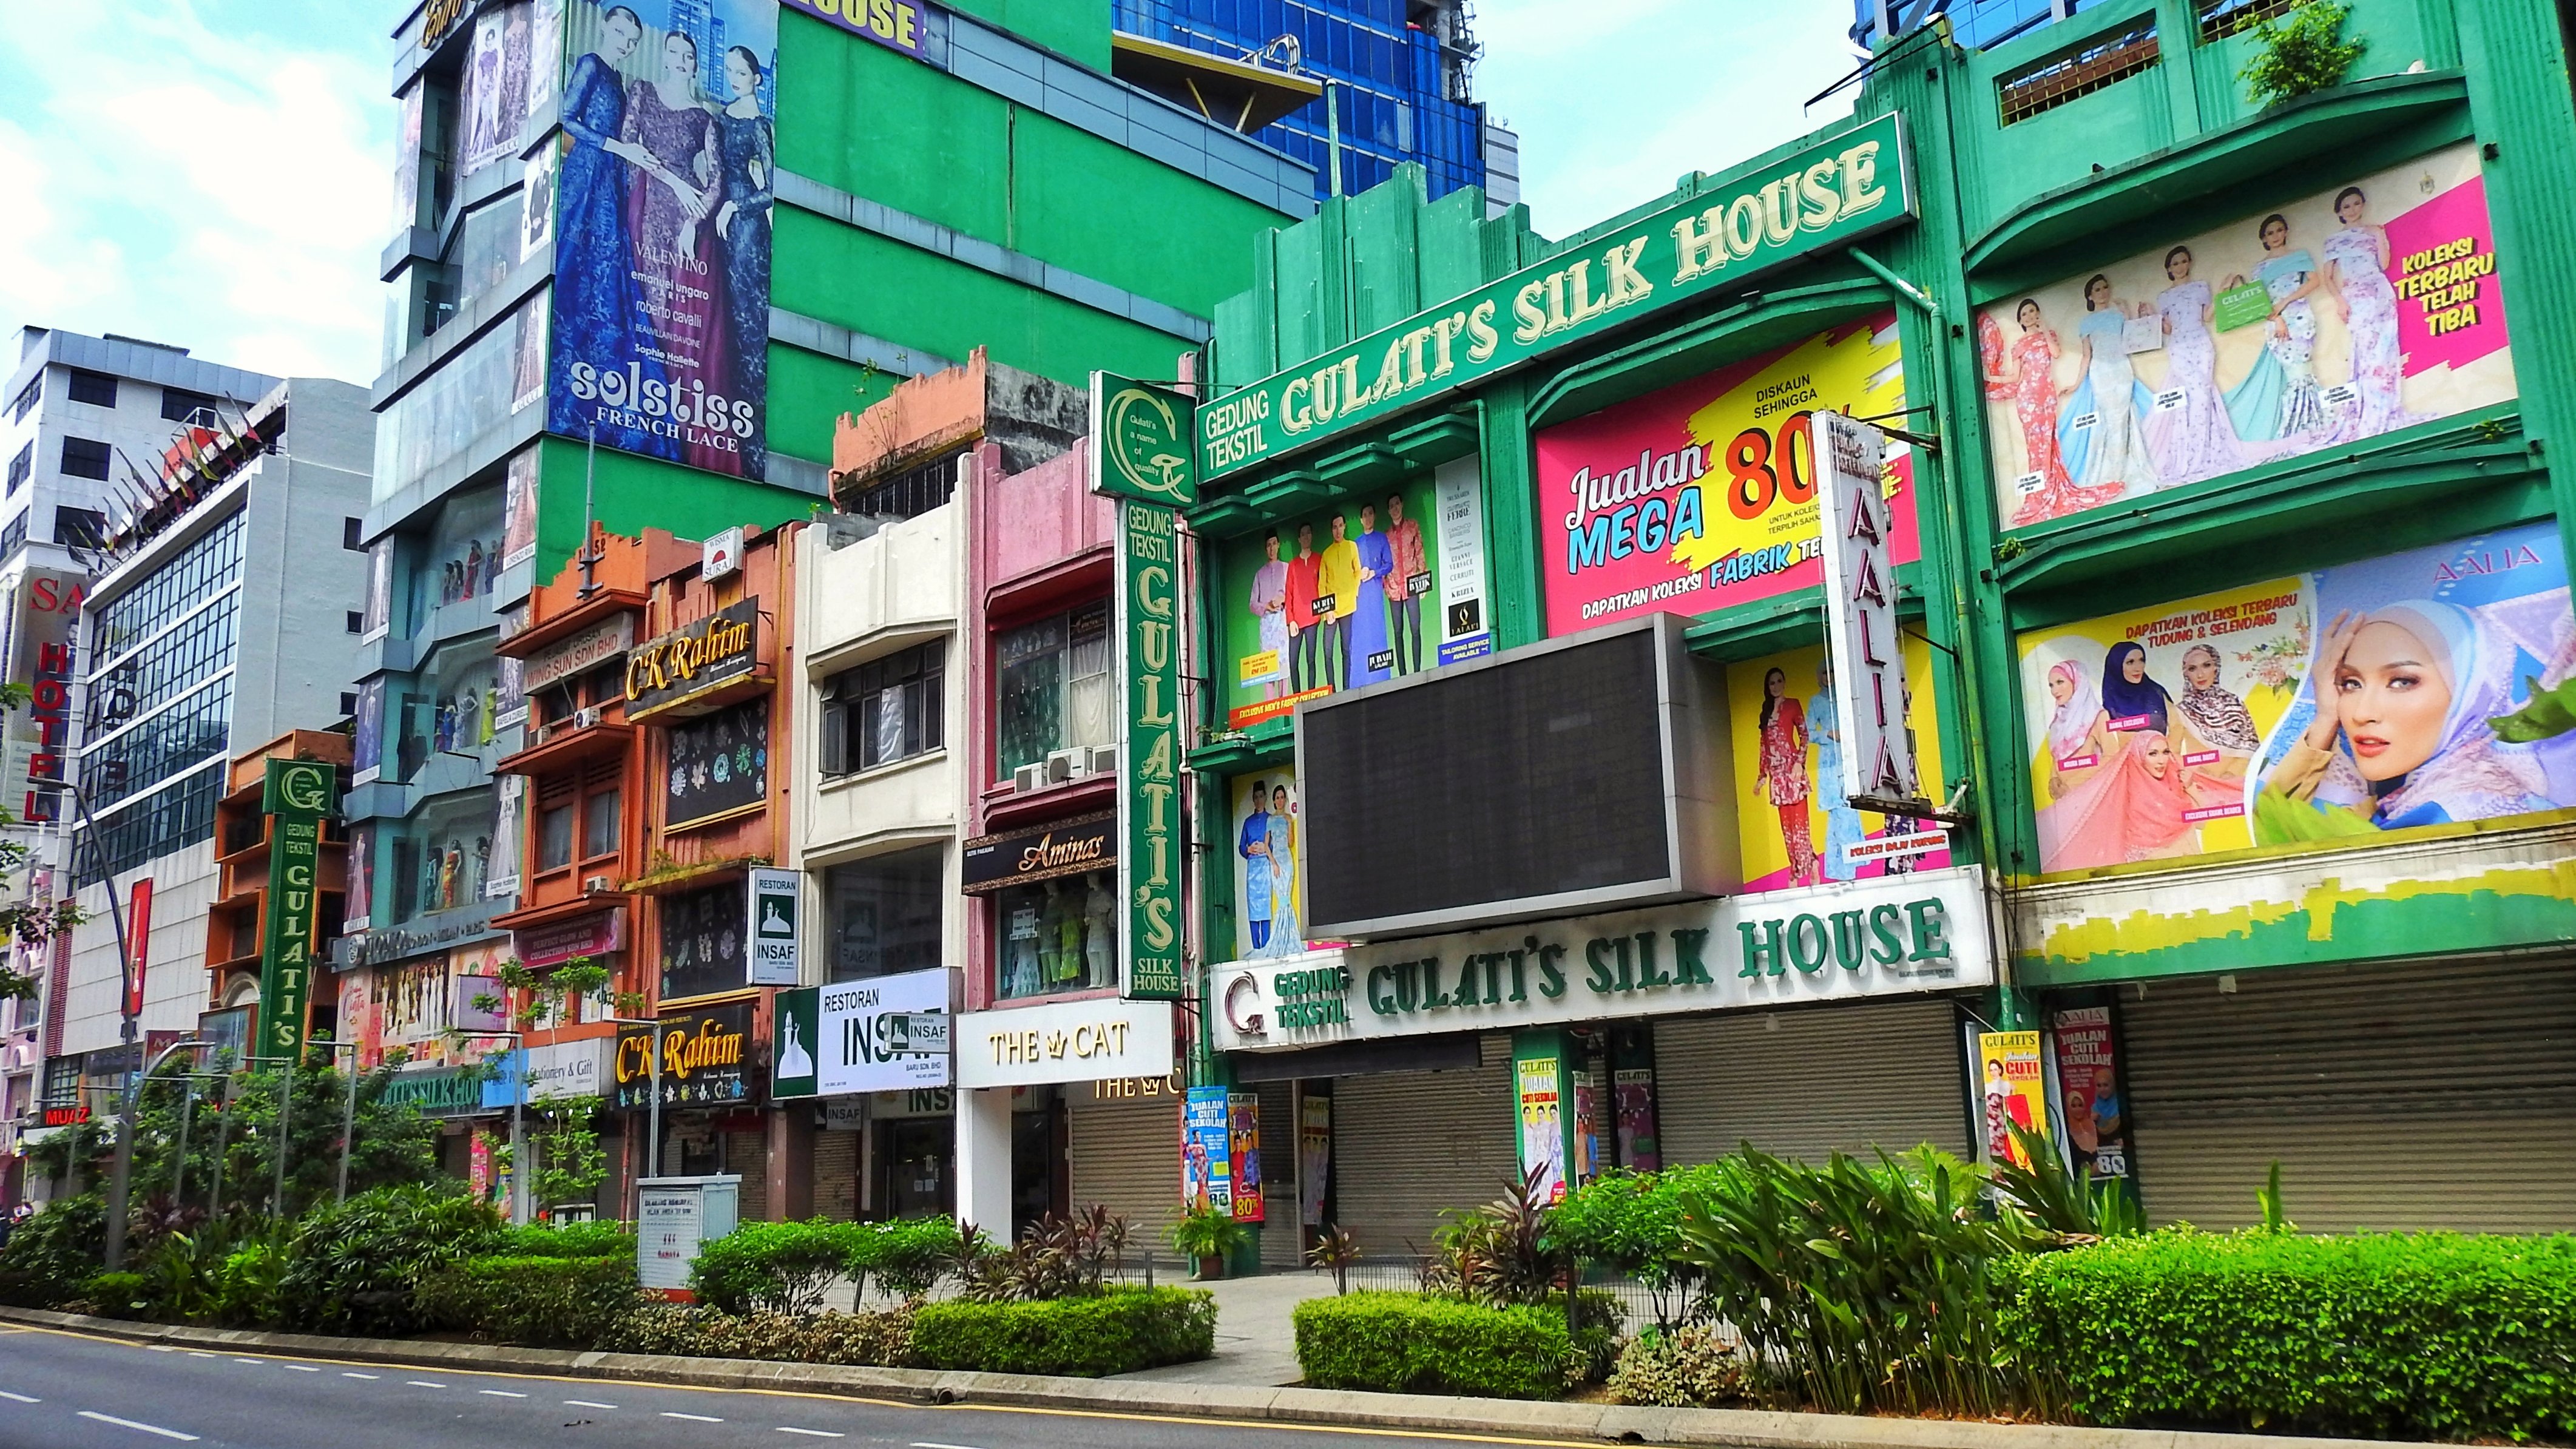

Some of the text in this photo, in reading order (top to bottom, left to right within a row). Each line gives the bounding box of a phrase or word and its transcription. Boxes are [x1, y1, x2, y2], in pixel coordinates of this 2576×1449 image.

[798, 0, 916, 50] USE
[636, 242, 708, 275] VALENTINO
[2402, 237, 2473, 274] KOLEKSI
[631, 271, 709, 300] emanuel ungaro
[1279, 140, 1887, 436] GULATI'S SILK HOUSE
[2393, 252, 2495, 300] TERBARU
[652, 287, 686, 303] PARIS
[2419, 280, 2476, 312] TELAH
[636, 300, 701, 328] roberto cavalli
[2424, 304, 2476, 336] TIBA
[635, 343, 665, 359] Sophie
[571, 361, 754, 438] solstiss
[1757, 374, 1811, 402] DISKAUN
[1206, 390, 1269, 439] GEDUNG
[1754, 388, 1818, 419] SEHINGGA
[597, 406, 739, 453] FRENCH LACE
[1130, 414, 1156, 430] Gulati's
[1134, 447, 1141, 456] of
[1137, 434, 1157, 445] name
[1206, 424, 1268, 470] TEKSTIL
[1135, 463, 1159, 476] quality
[1565, 444, 1705, 530] Jualan
[1128, 505, 1172, 536] GEDUNG
[1567, 485, 1703, 575] MEGA
[1768, 521, 1798, 535] TERPILIH
[1769, 512, 1793, 524] UNTUK
[709, 534, 730, 547] WISMA
[1129, 532, 1171, 562] TEKSTIL
[704, 558, 732, 578] SURAJ
[1449, 559, 1473, 570] VERSACE
[1450, 569, 1474, 582] CERRUTI
[2433, 544, 2542, 586] AALIA
[1582, 535, 1824, 620] DAPATKAN KOLEKSI FABRIK TE
[1451, 587, 1474, 598] KRIZIA
[2126, 593, 2297, 639] DAPATKAN KOLEKSI TERBARU
[1848, 487, 1904, 794] AALIA
[2148, 612, 2277, 648] TUDUNG & SELENDANG
[527, 634, 618, 687] WING SUN SDN BHD
[671, 617, 750, 680] Rahim
[1240, 705, 1264, 718] EXCLUSIVE
[1265, 700, 1280, 713] MEN'S
[24, 643, 68, 821] HOTEL
[1134, 566, 1174, 952] GULATI'S
[286, 823, 315, 837] GEDUNG
[285, 841, 313, 855] TEKSTIL
[1019, 833, 1105, 871] Aminas
[759, 879, 796, 890] RESTORAN
[272, 865, 311, 1046] GULATI'S
[530, 945, 566, 961] COLLECTION
[757, 944, 794, 960] INSAF
[1367, 896, 1950, 1015] GULATI'S SILK HOUSE
[1138, 958, 1173, 974] SILK
[1133, 974, 1178, 991] HOUSE
[1274, 965, 1354, 997] GEDUNG
[824, 988, 879, 1013] RESTORAN
[1275, 998, 1351, 1028] TEKSTIL
[843, 1008, 941, 1066] INS
[910, 1025, 947, 1038] INSAF
[989, 1021, 1129, 1064] THE CAT
[1985, 1034, 2036, 1048] GULATI'S
[2060, 1030, 2107, 1045] JUALAN
[664, 1019, 744, 1079] Rahim
[2061, 1053, 2112, 1066] SEKOLAH
[2070, 1042, 2099, 1054] CUTI
[567, 1062, 575, 1075] &
[576, 1059, 592, 1075] Gift
[1520, 1061, 1556, 1073] GULATI'S
[2006, 1062, 2040, 1075] CUTI
[1524, 1076, 1554, 1092] JUALAN
[909, 1089, 955, 1112] INS
[1191, 1100, 1223, 1112] JUALAN
[828, 1109, 860, 1120] INSAF
[1189, 1118, 1227, 1128] SEKOLAH
[1198, 1109, 1218, 1118] CUTI
[1236, 1198, 1258, 1215] 80%
